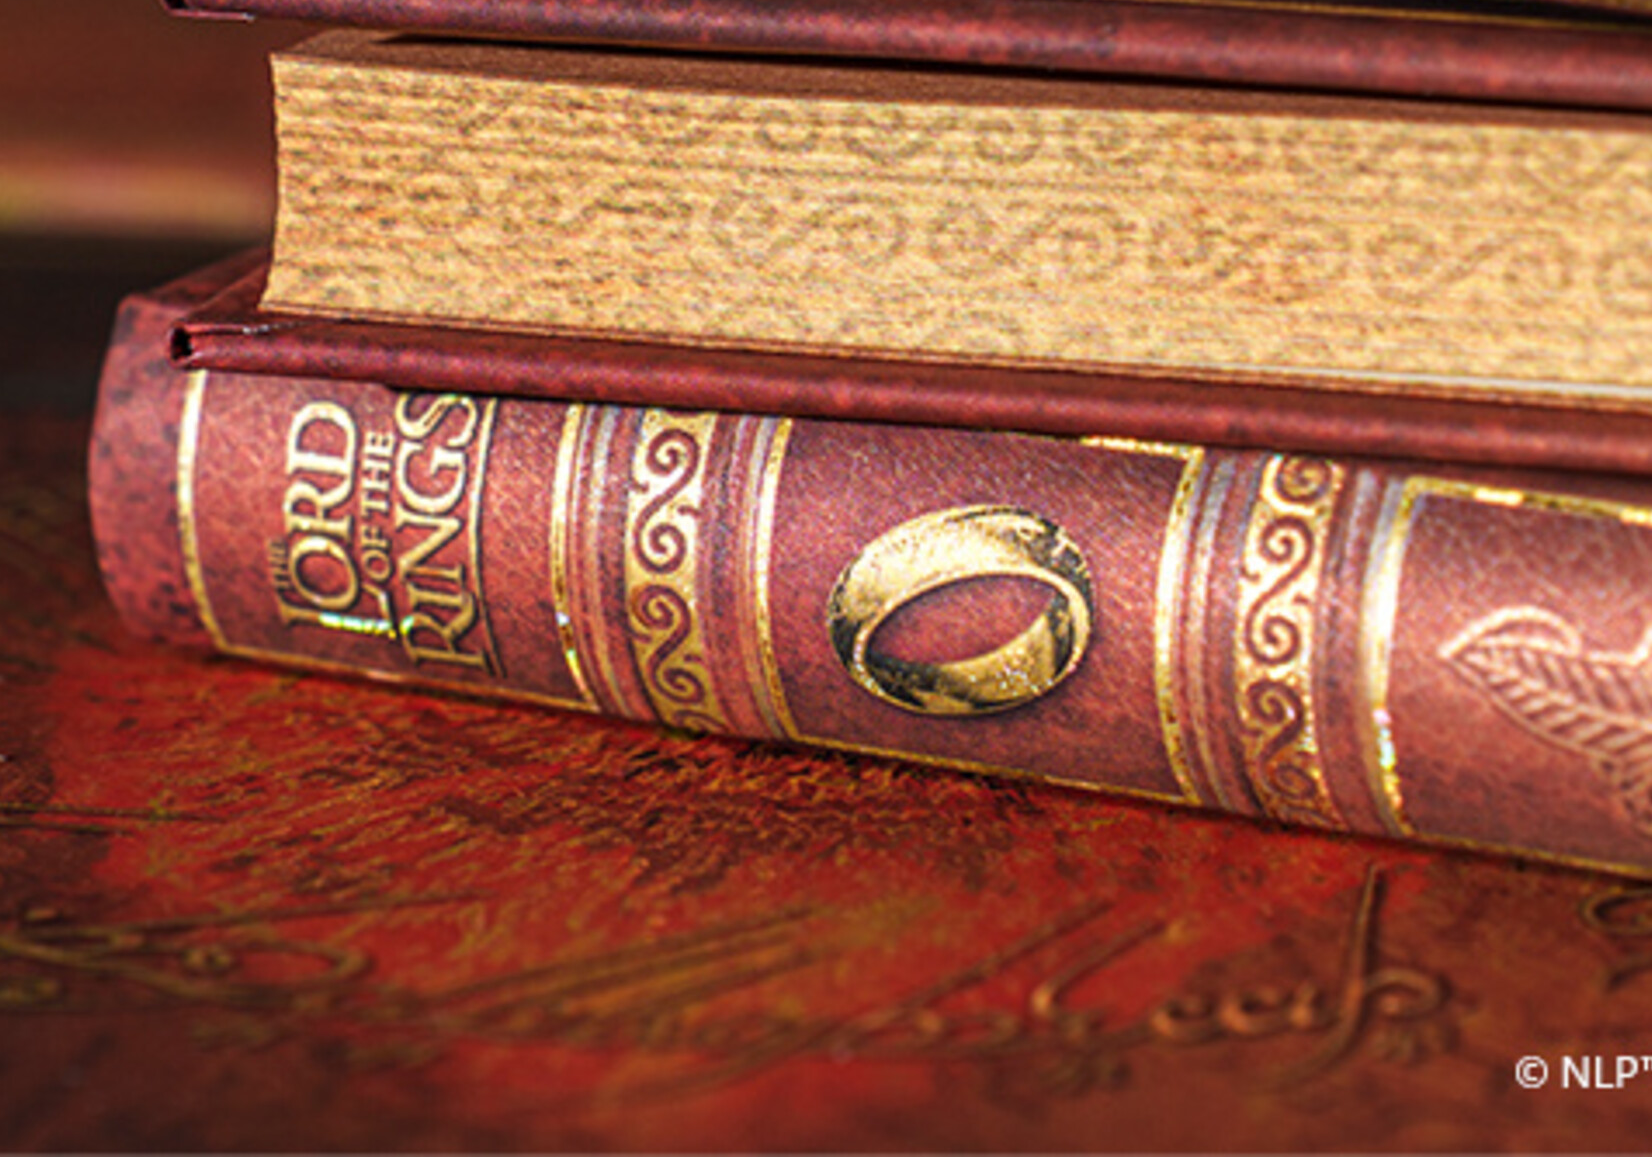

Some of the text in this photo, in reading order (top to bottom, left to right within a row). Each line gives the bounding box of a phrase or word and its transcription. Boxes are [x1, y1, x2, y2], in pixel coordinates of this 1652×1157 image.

[283, 401, 396, 639] LORD
[361, 430, 394, 581] OF THE
[395, 394, 494, 673] RINGS
